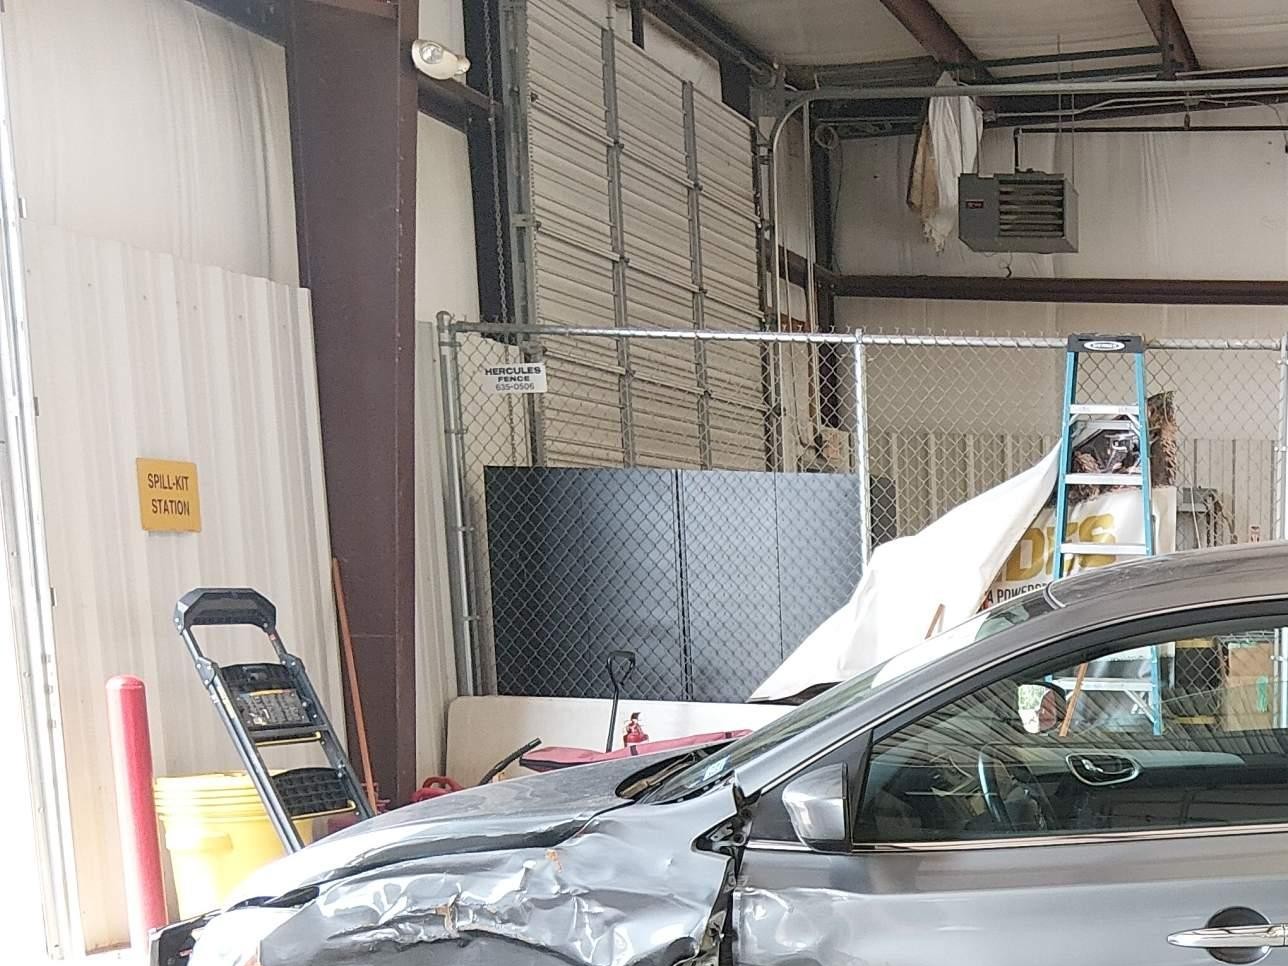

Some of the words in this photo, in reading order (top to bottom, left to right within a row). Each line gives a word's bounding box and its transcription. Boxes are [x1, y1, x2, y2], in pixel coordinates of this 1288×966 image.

[485, 367, 541, 375] HERCULES
[147, 473, 189, 491] SPILL-KIT
[151, 499, 190, 516] STATION
